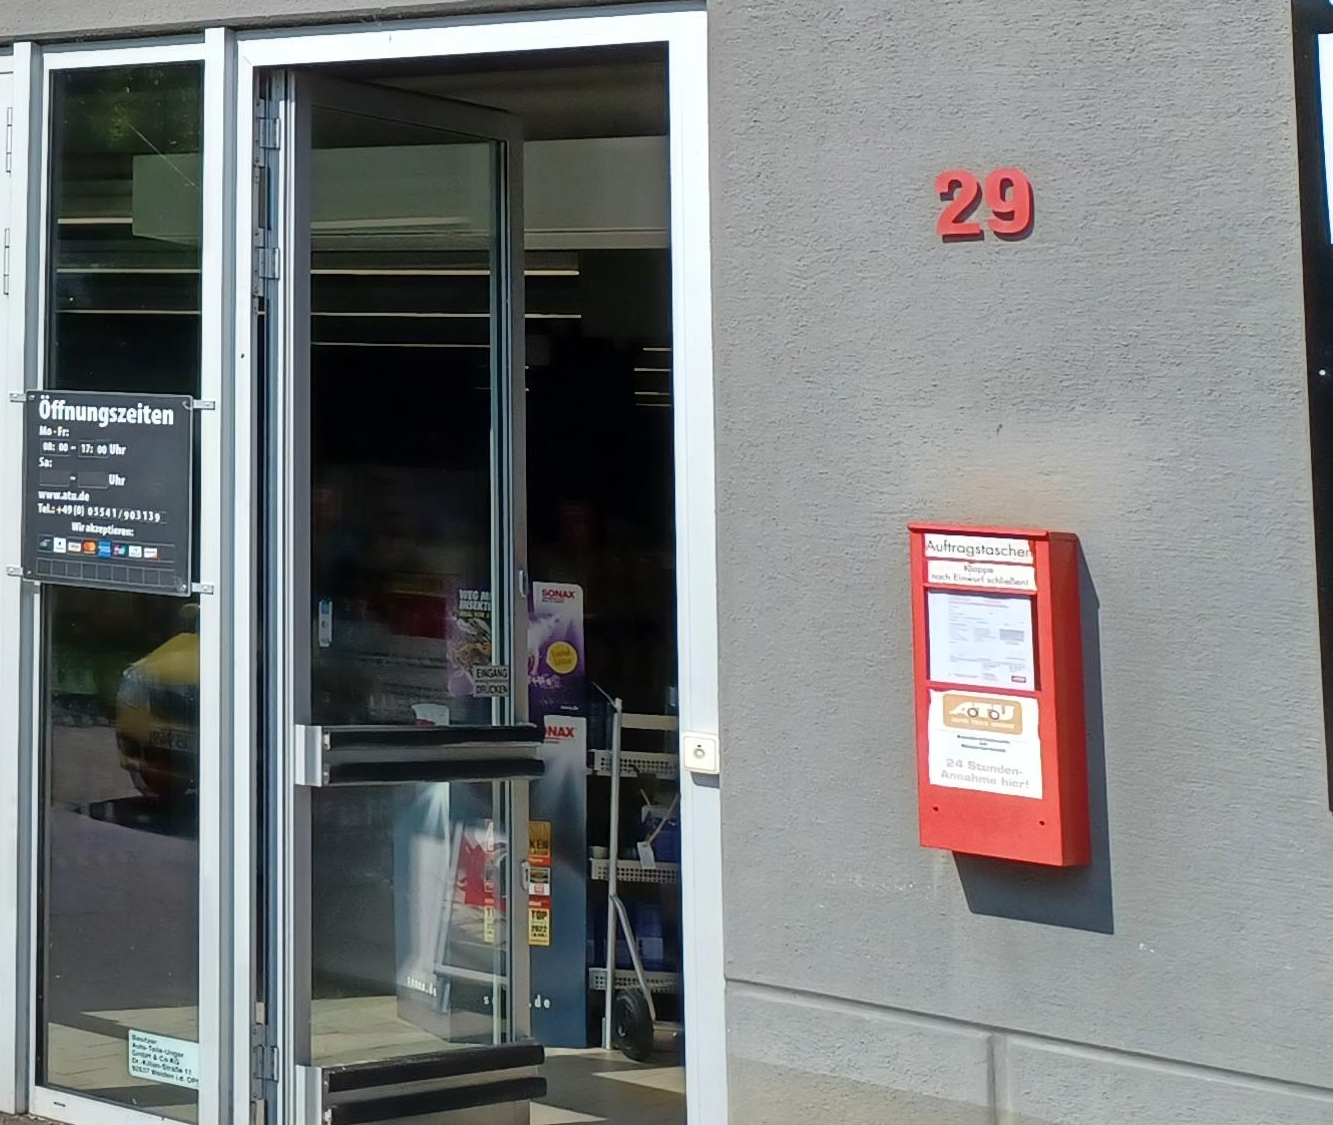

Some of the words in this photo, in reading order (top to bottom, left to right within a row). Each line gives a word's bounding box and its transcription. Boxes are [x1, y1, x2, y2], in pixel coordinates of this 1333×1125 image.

[935, 168, 1032, 237] 29
[39, 394, 174, 427] Öffnungszeiten
[39, 426, 52, 436] Mo
[57, 426, 69, 437] Fr:
[109, 443, 126, 455] Uhr
[38, 456, 52, 467] Sa:
[108, 474, 125, 486] Uhr
[38, 490, 90, 502] www.atu.de
[37, 503, 55, 514] Tel.:
[71, 522, 85, 532] Wir
[85, 523, 134, 536] akzeptieren:
[963, 564, 994, 574] Klappe
[931, 573, 950, 581] nach
[541, 588, 575, 599] SONAX
[476, 668, 508, 679] EINGANG
[544, 726, 575, 738] NAX
[946, 758, 963, 768] 24
[967, 760, 1023, 775] Stunden-
[940, 770, 997, 785] Annahme
[1001, 777, 1029, 789] hier!
